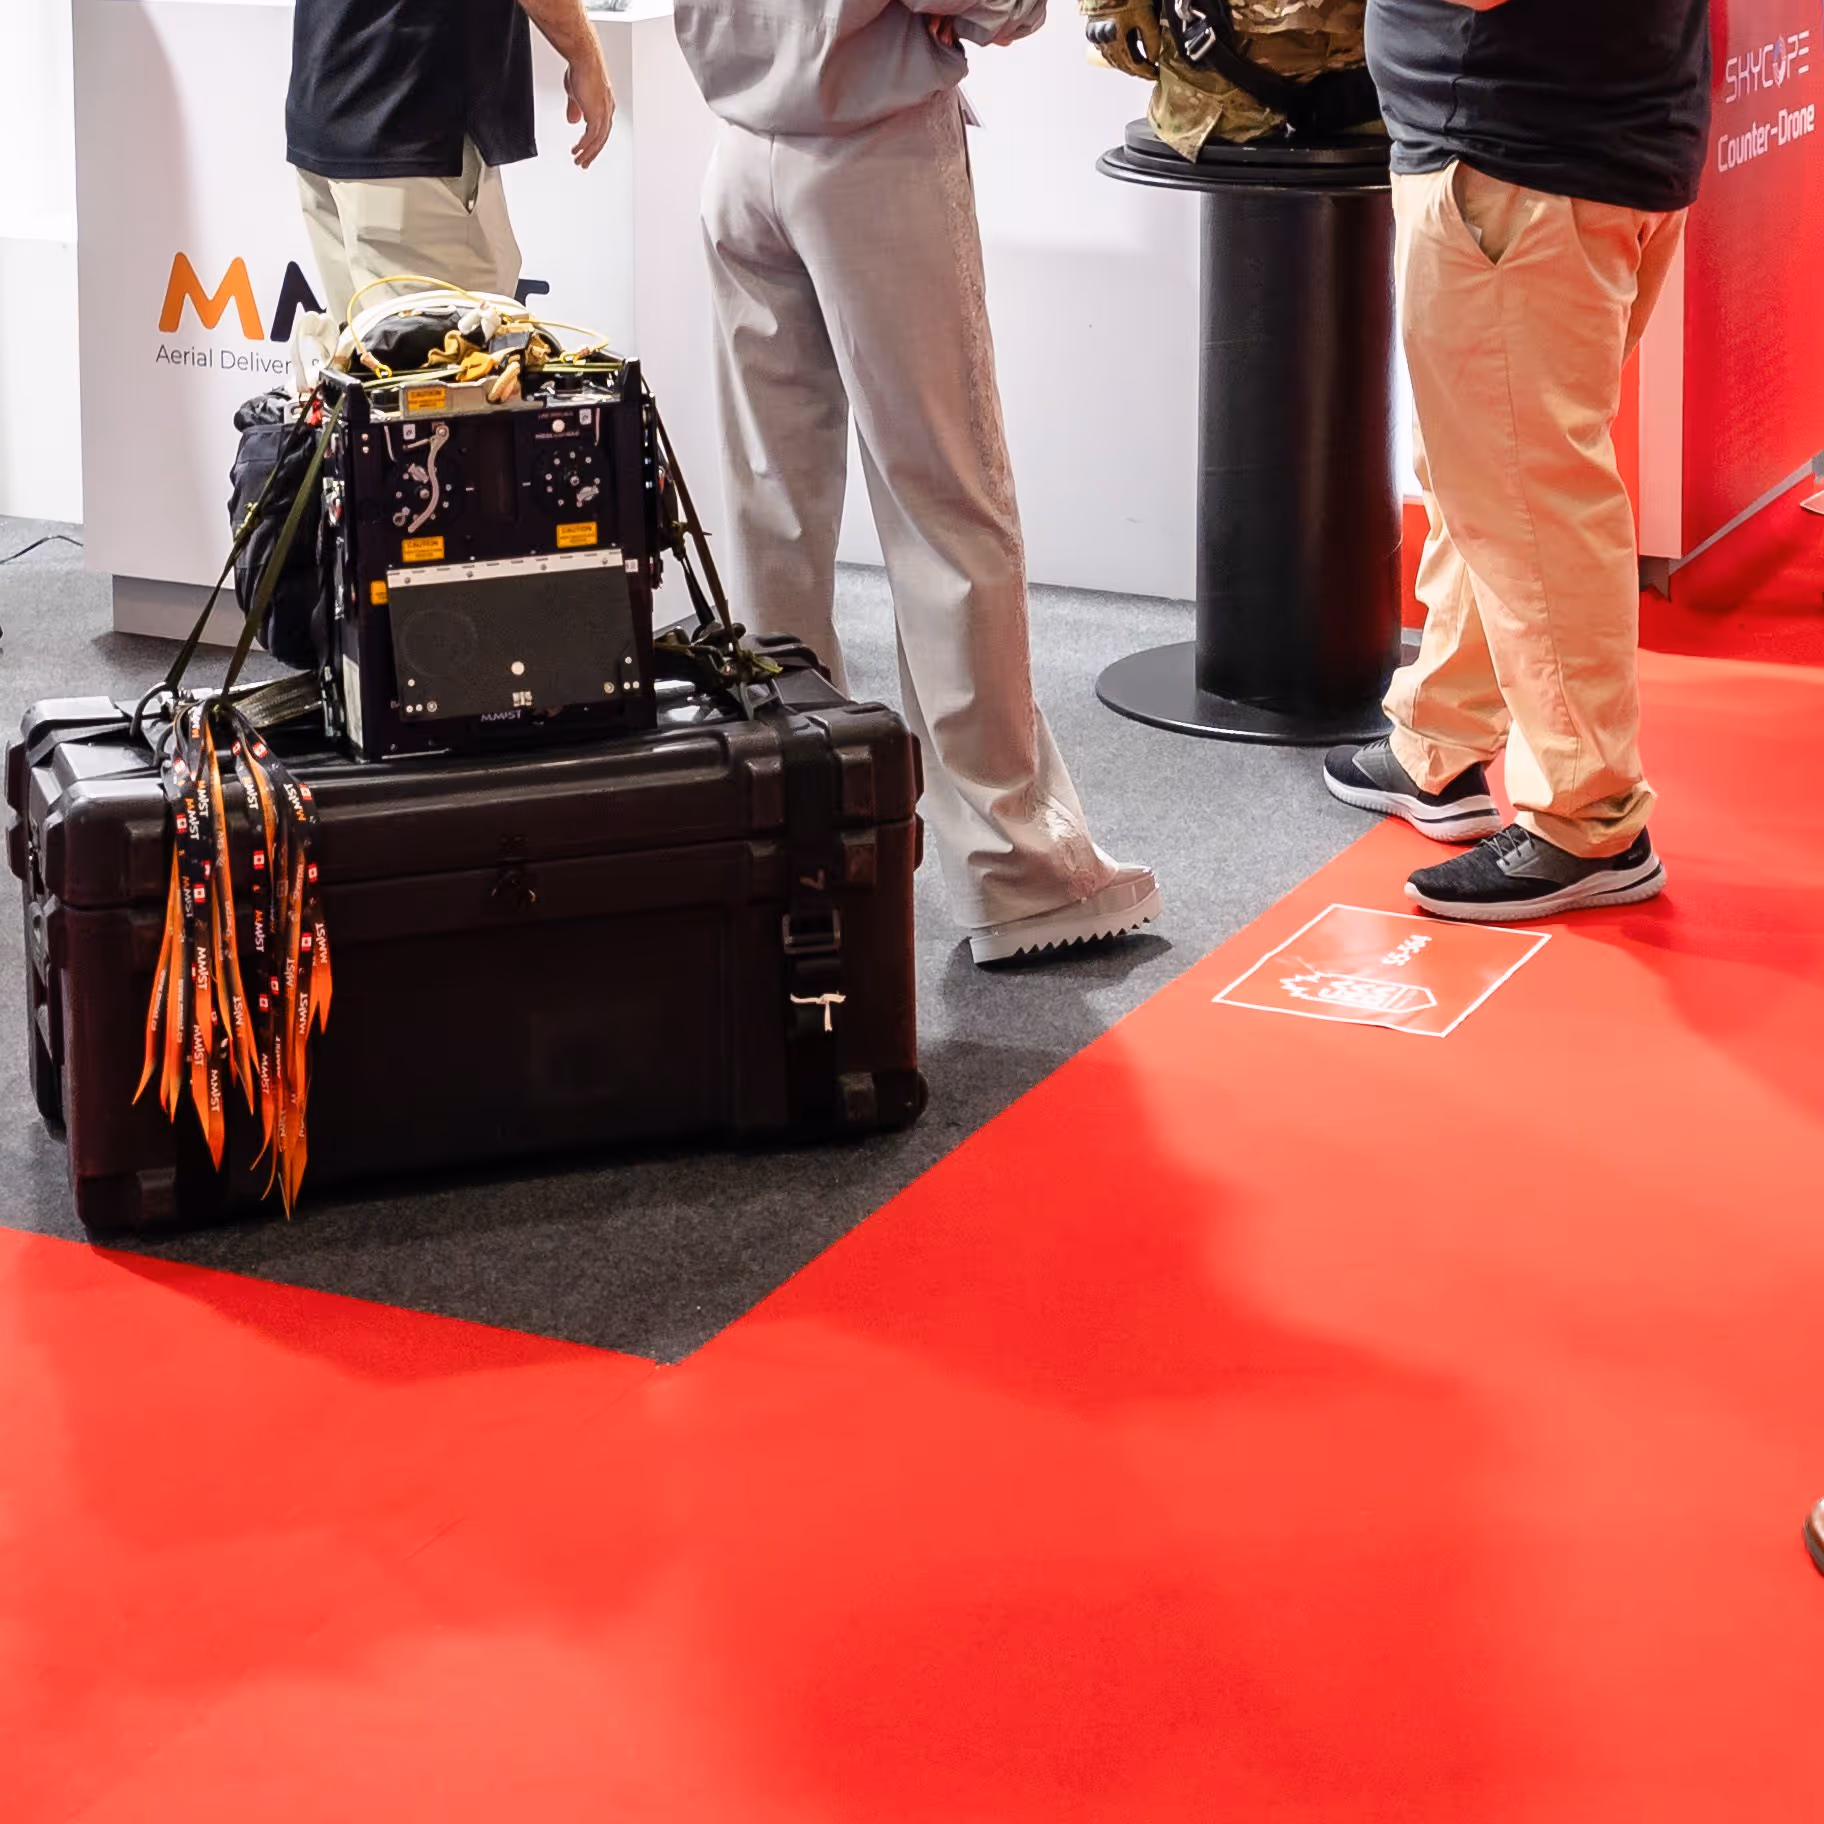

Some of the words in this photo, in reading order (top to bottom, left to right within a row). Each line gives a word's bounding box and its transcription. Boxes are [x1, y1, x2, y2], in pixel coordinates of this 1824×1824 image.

[1717, 103, 1816, 173] Counter-Drone
[155, 344, 214, 369] Aerial
[220, 349, 292, 375] Deliver
[184, 797, 200, 840] MMIST
[284, 783, 307, 822] MMIST
[197, 946, 209, 990] MMIST
[298, 991, 309, 1035] MMIST
[193, 1024, 205, 1066] MMIST
[210, 1069, 222, 1113] MMIST
